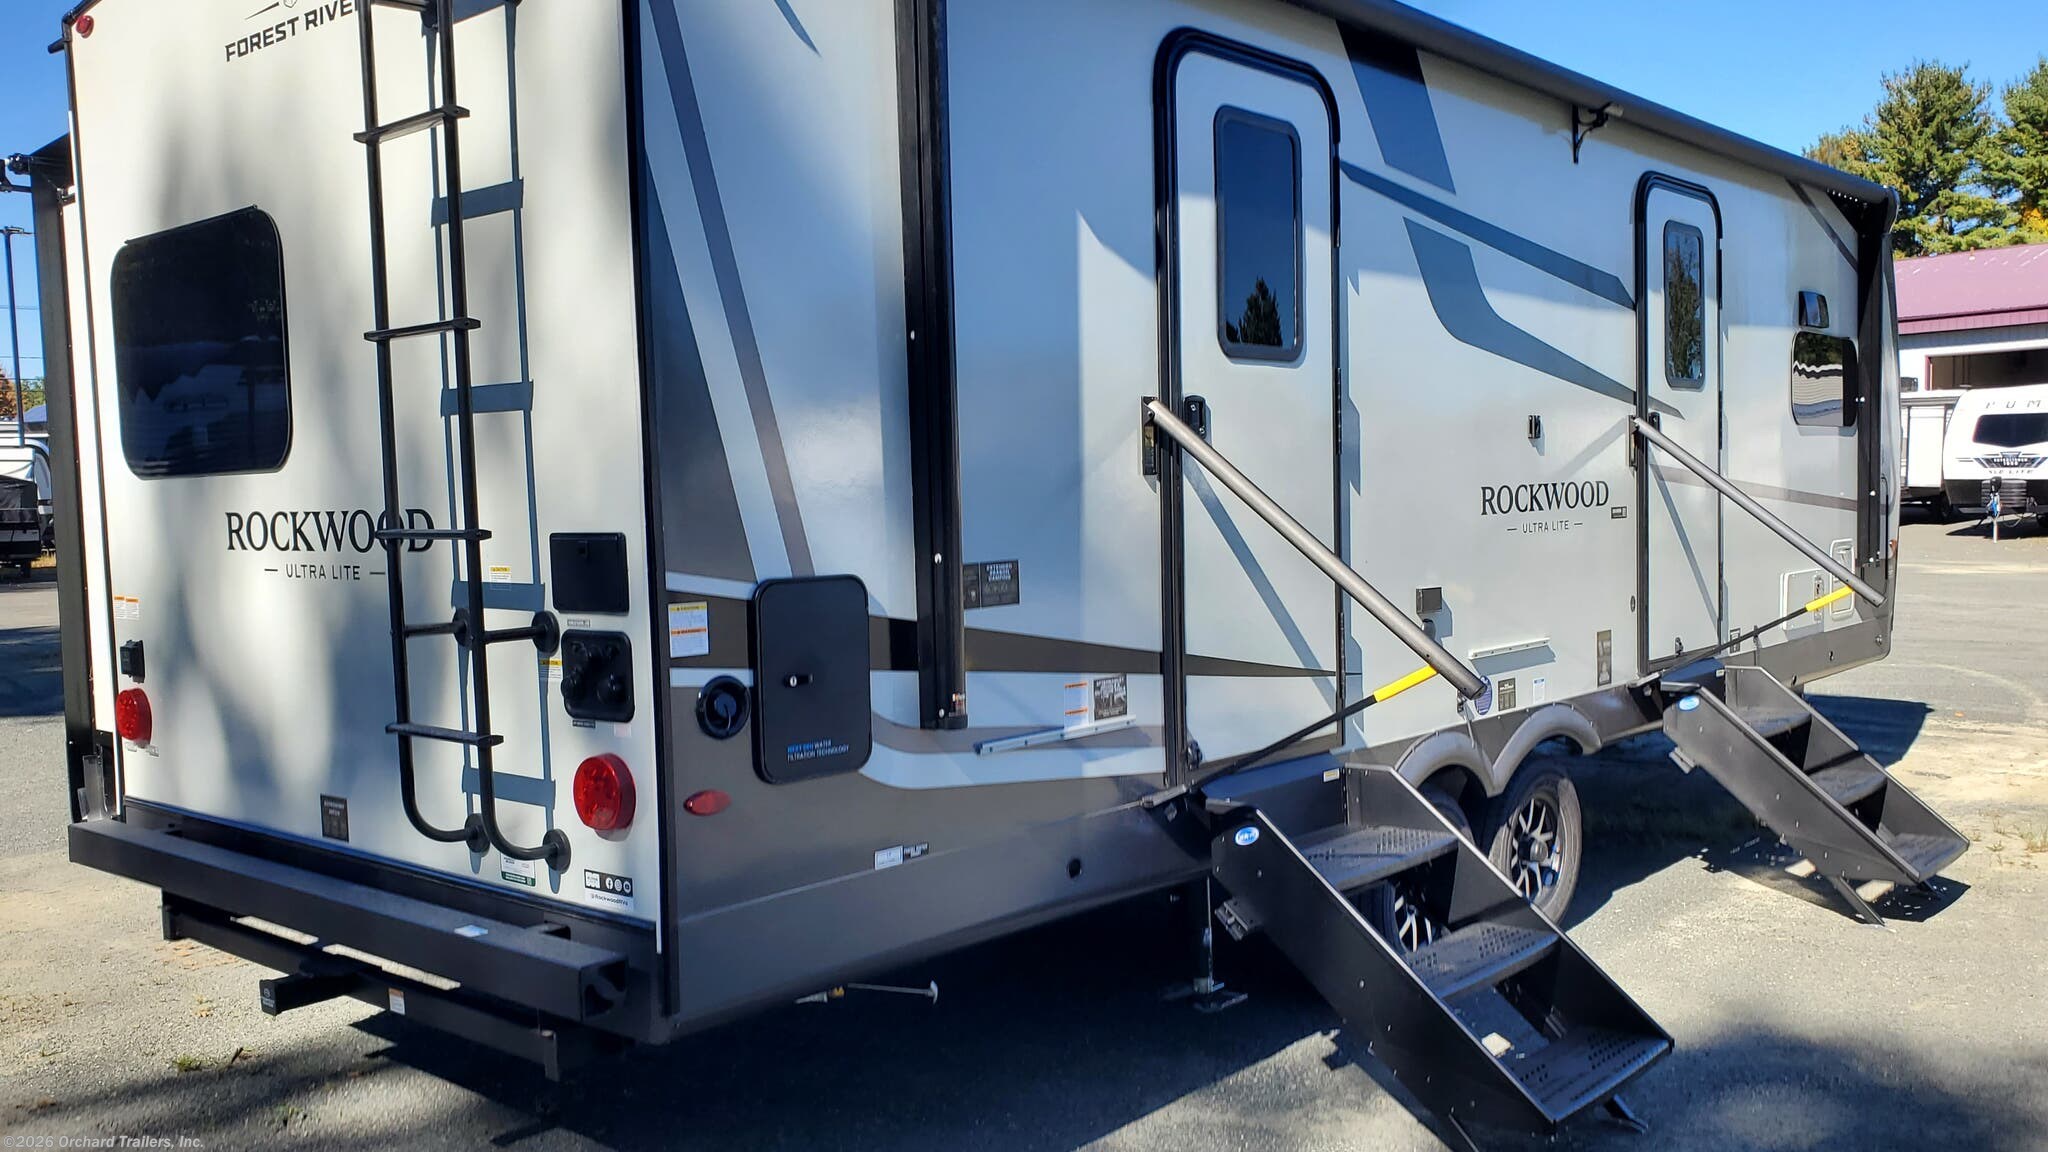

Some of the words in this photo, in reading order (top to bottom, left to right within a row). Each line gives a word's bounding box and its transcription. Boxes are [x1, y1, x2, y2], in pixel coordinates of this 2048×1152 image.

[225, 16, 299, 62] FOREST
[304, 0, 358, 31] RIVE
[1481, 480, 1609, 515] ROCKWOOD
[225, 508, 435, 554] ROCKWOOD
[1522, 522, 1549, 533] ULTRA
[1552, 520, 1569, 531] LITE
[286, 564, 326, 579] ULTRA
[332, 565, 361, 580] LITE
